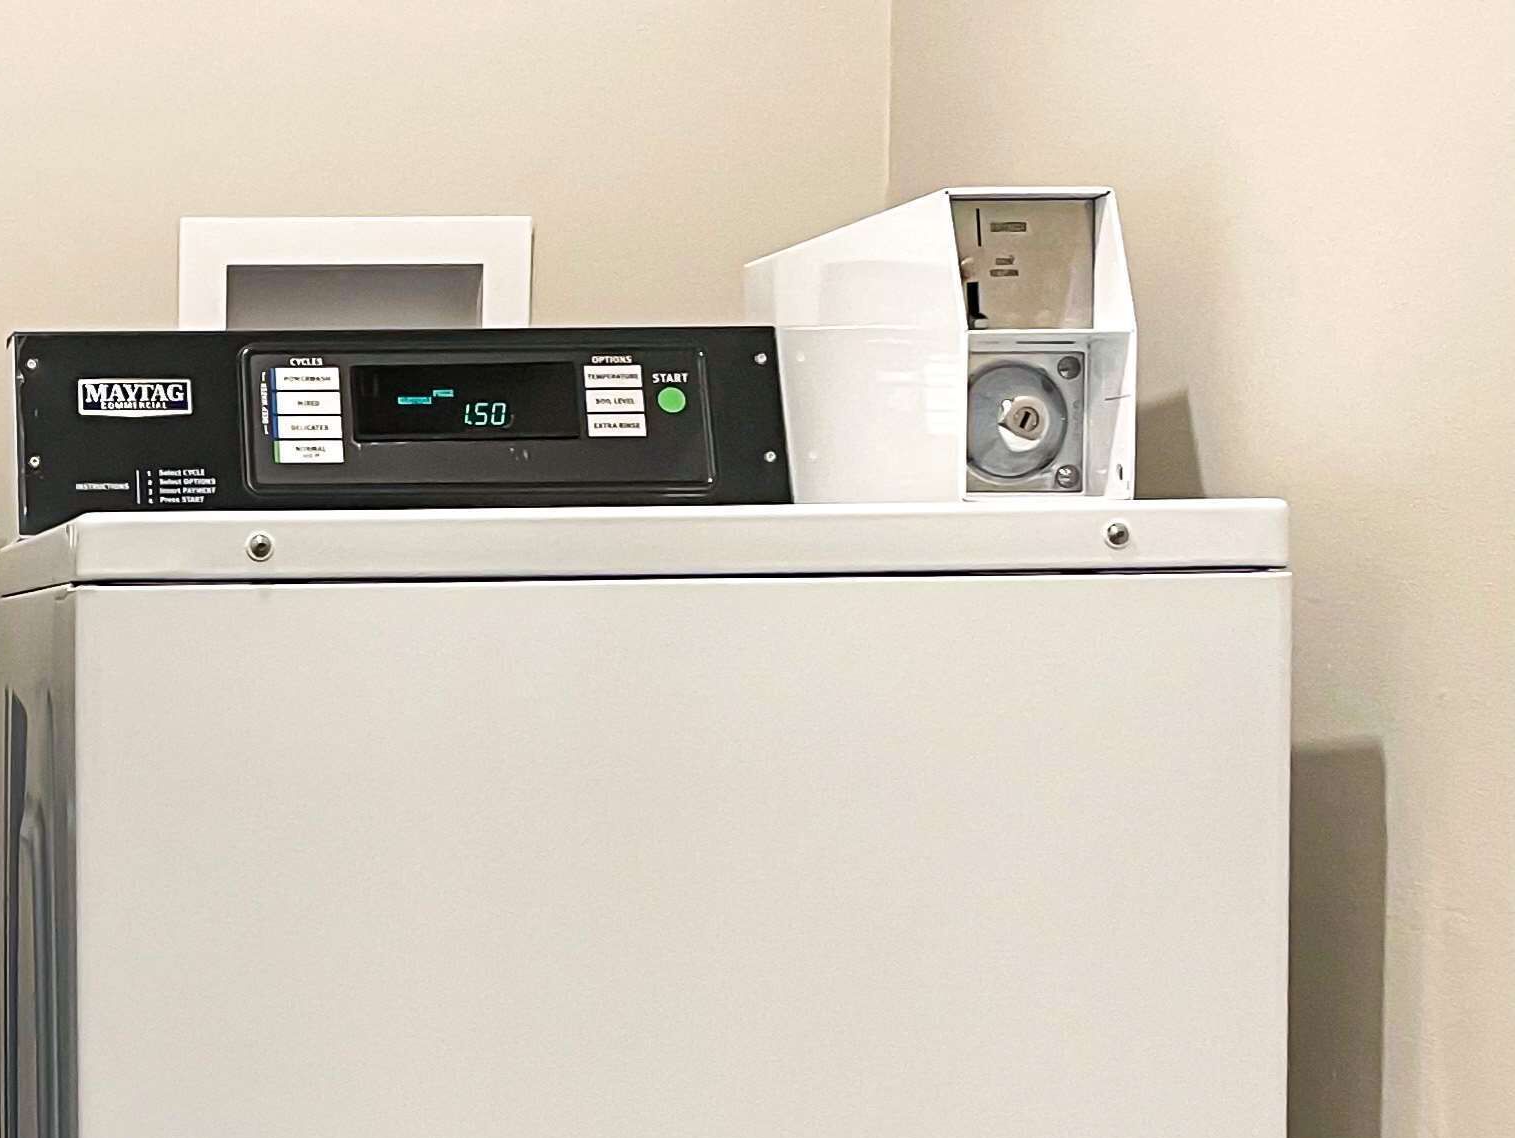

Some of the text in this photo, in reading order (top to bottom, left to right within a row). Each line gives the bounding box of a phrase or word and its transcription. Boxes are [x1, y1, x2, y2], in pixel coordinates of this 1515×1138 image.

[289, 357, 323, 367] CYCLES
[591, 355, 633, 364] OPTIONS
[652, 373, 689, 384] START
[84, 383, 185, 403] MAYTAG
[100, 401, 167, 410] COMMERCIAL
[181, 496, 205, 504] START
